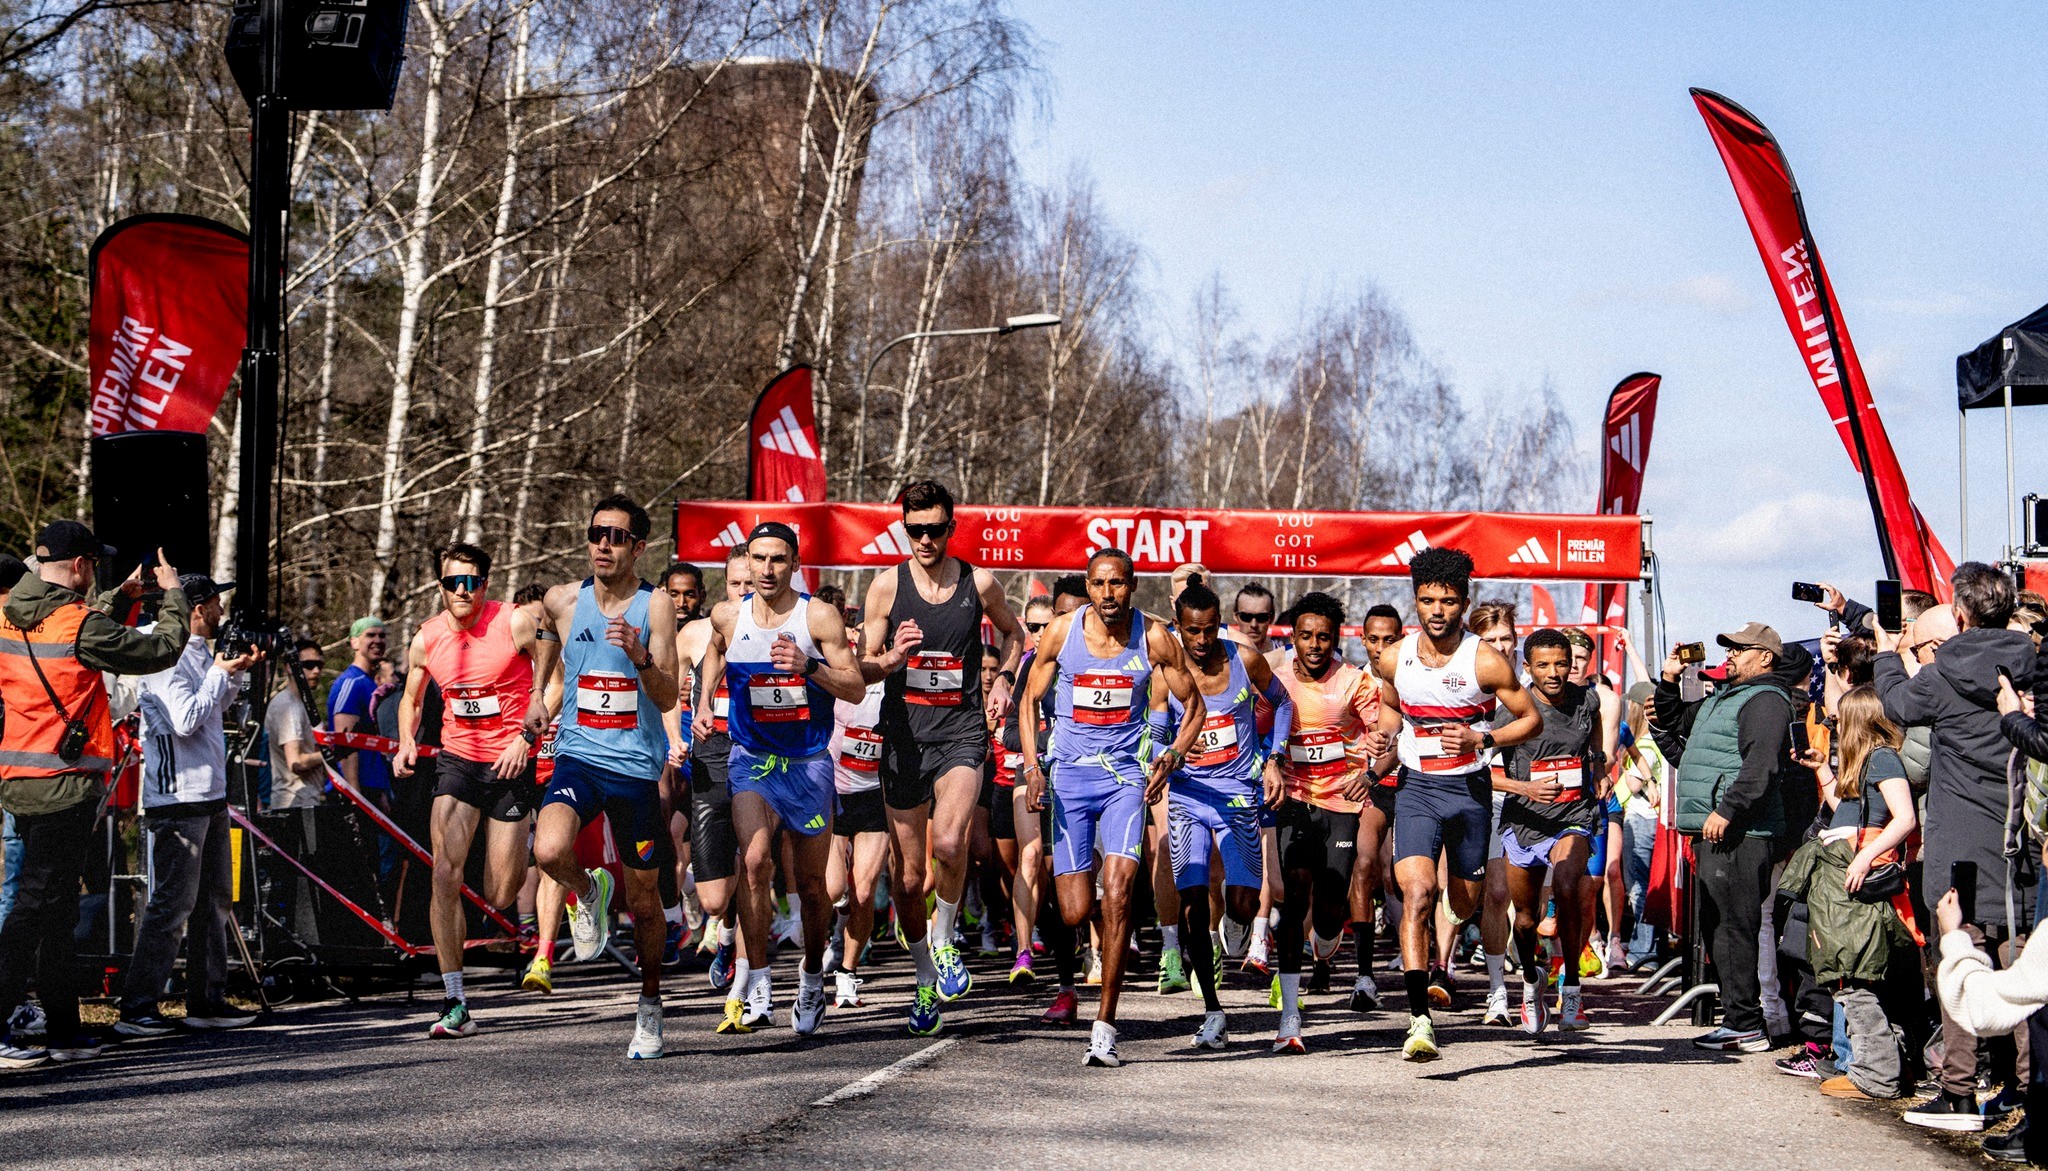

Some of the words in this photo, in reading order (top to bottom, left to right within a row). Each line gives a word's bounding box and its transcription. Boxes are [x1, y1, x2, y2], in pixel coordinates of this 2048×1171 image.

[92, 315, 155, 436] PREMIÄR
[124, 334, 193, 431] ILEN
[984, 509, 1021, 522] YOU
[1276, 512, 1315, 528] YOU
[982, 528, 1021, 542] GOT
[1085, 518, 1209, 563] START
[1274, 534, 1315, 547] GOT
[1567, 538, 1605, 551] PREMIÄR
[979, 548, 1024, 562] THIS
[1271, 553, 1318, 568] THIS
[1567, 551, 1605, 563] MILEN
[930, 672, 939, 687] 5
[601, 693, 611, 709] 2
[773, 689, 782, 704] 8
[1093, 690, 1112, 706] 24
[464, 700, 481, 714] 28
[1201, 731, 1219, 747] 18
[854, 741, 877, 757] 471
[1307, 746, 1324, 761] 27
